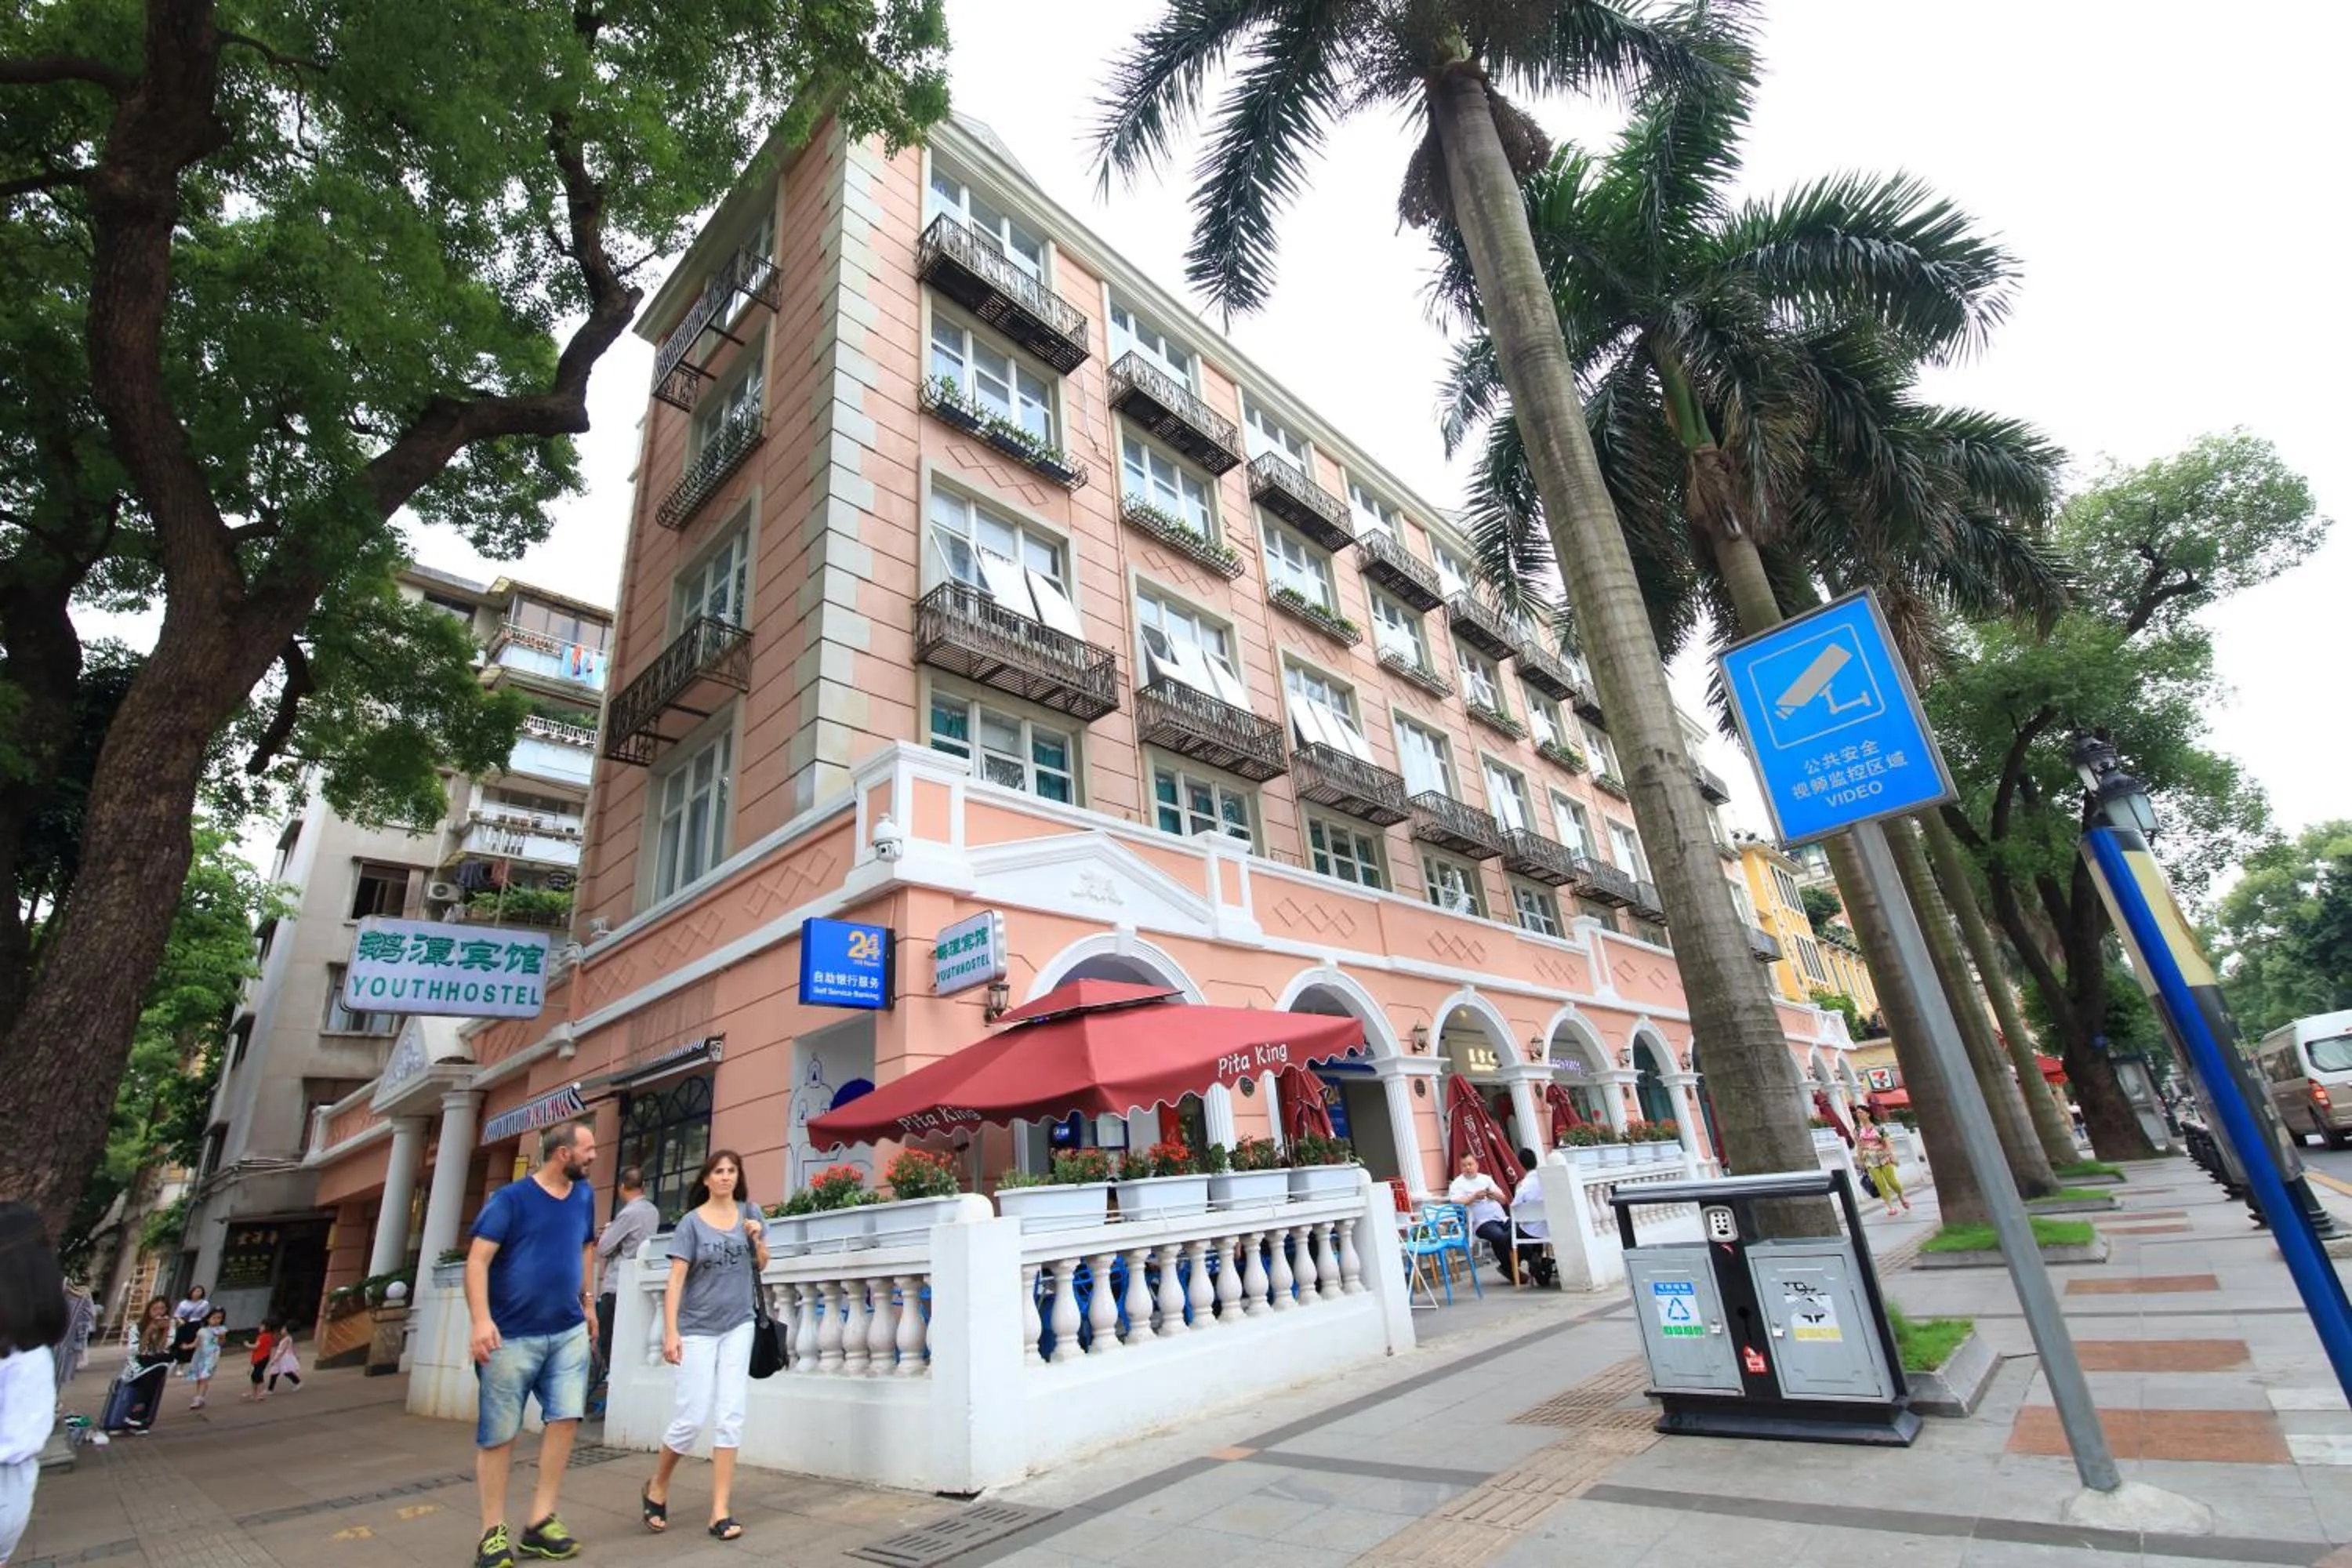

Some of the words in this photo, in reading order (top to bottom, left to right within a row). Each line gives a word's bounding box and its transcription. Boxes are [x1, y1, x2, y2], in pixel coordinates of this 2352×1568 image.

[1803, 739, 1880, 775] 公共安全
[1791, 750, 1908, 800] 视频监控区域
[1825, 780, 1882, 808] VIDEO
[848, 930, 880, 960] 24
[352, 975, 541, 1006] YOUTHHOSTEL
[813, 971, 879, 989] 自助银行服务
[813, 986, 827, 995] Self
[828, 988, 853, 996] Service
[853, 990, 880, 1001] Banking
[1218, 1052, 1251, 1079] Pita
[1254, 1043, 1288, 1066] King
[897, 1113, 938, 1131] Pita
[937, 1105, 982, 1123] King
